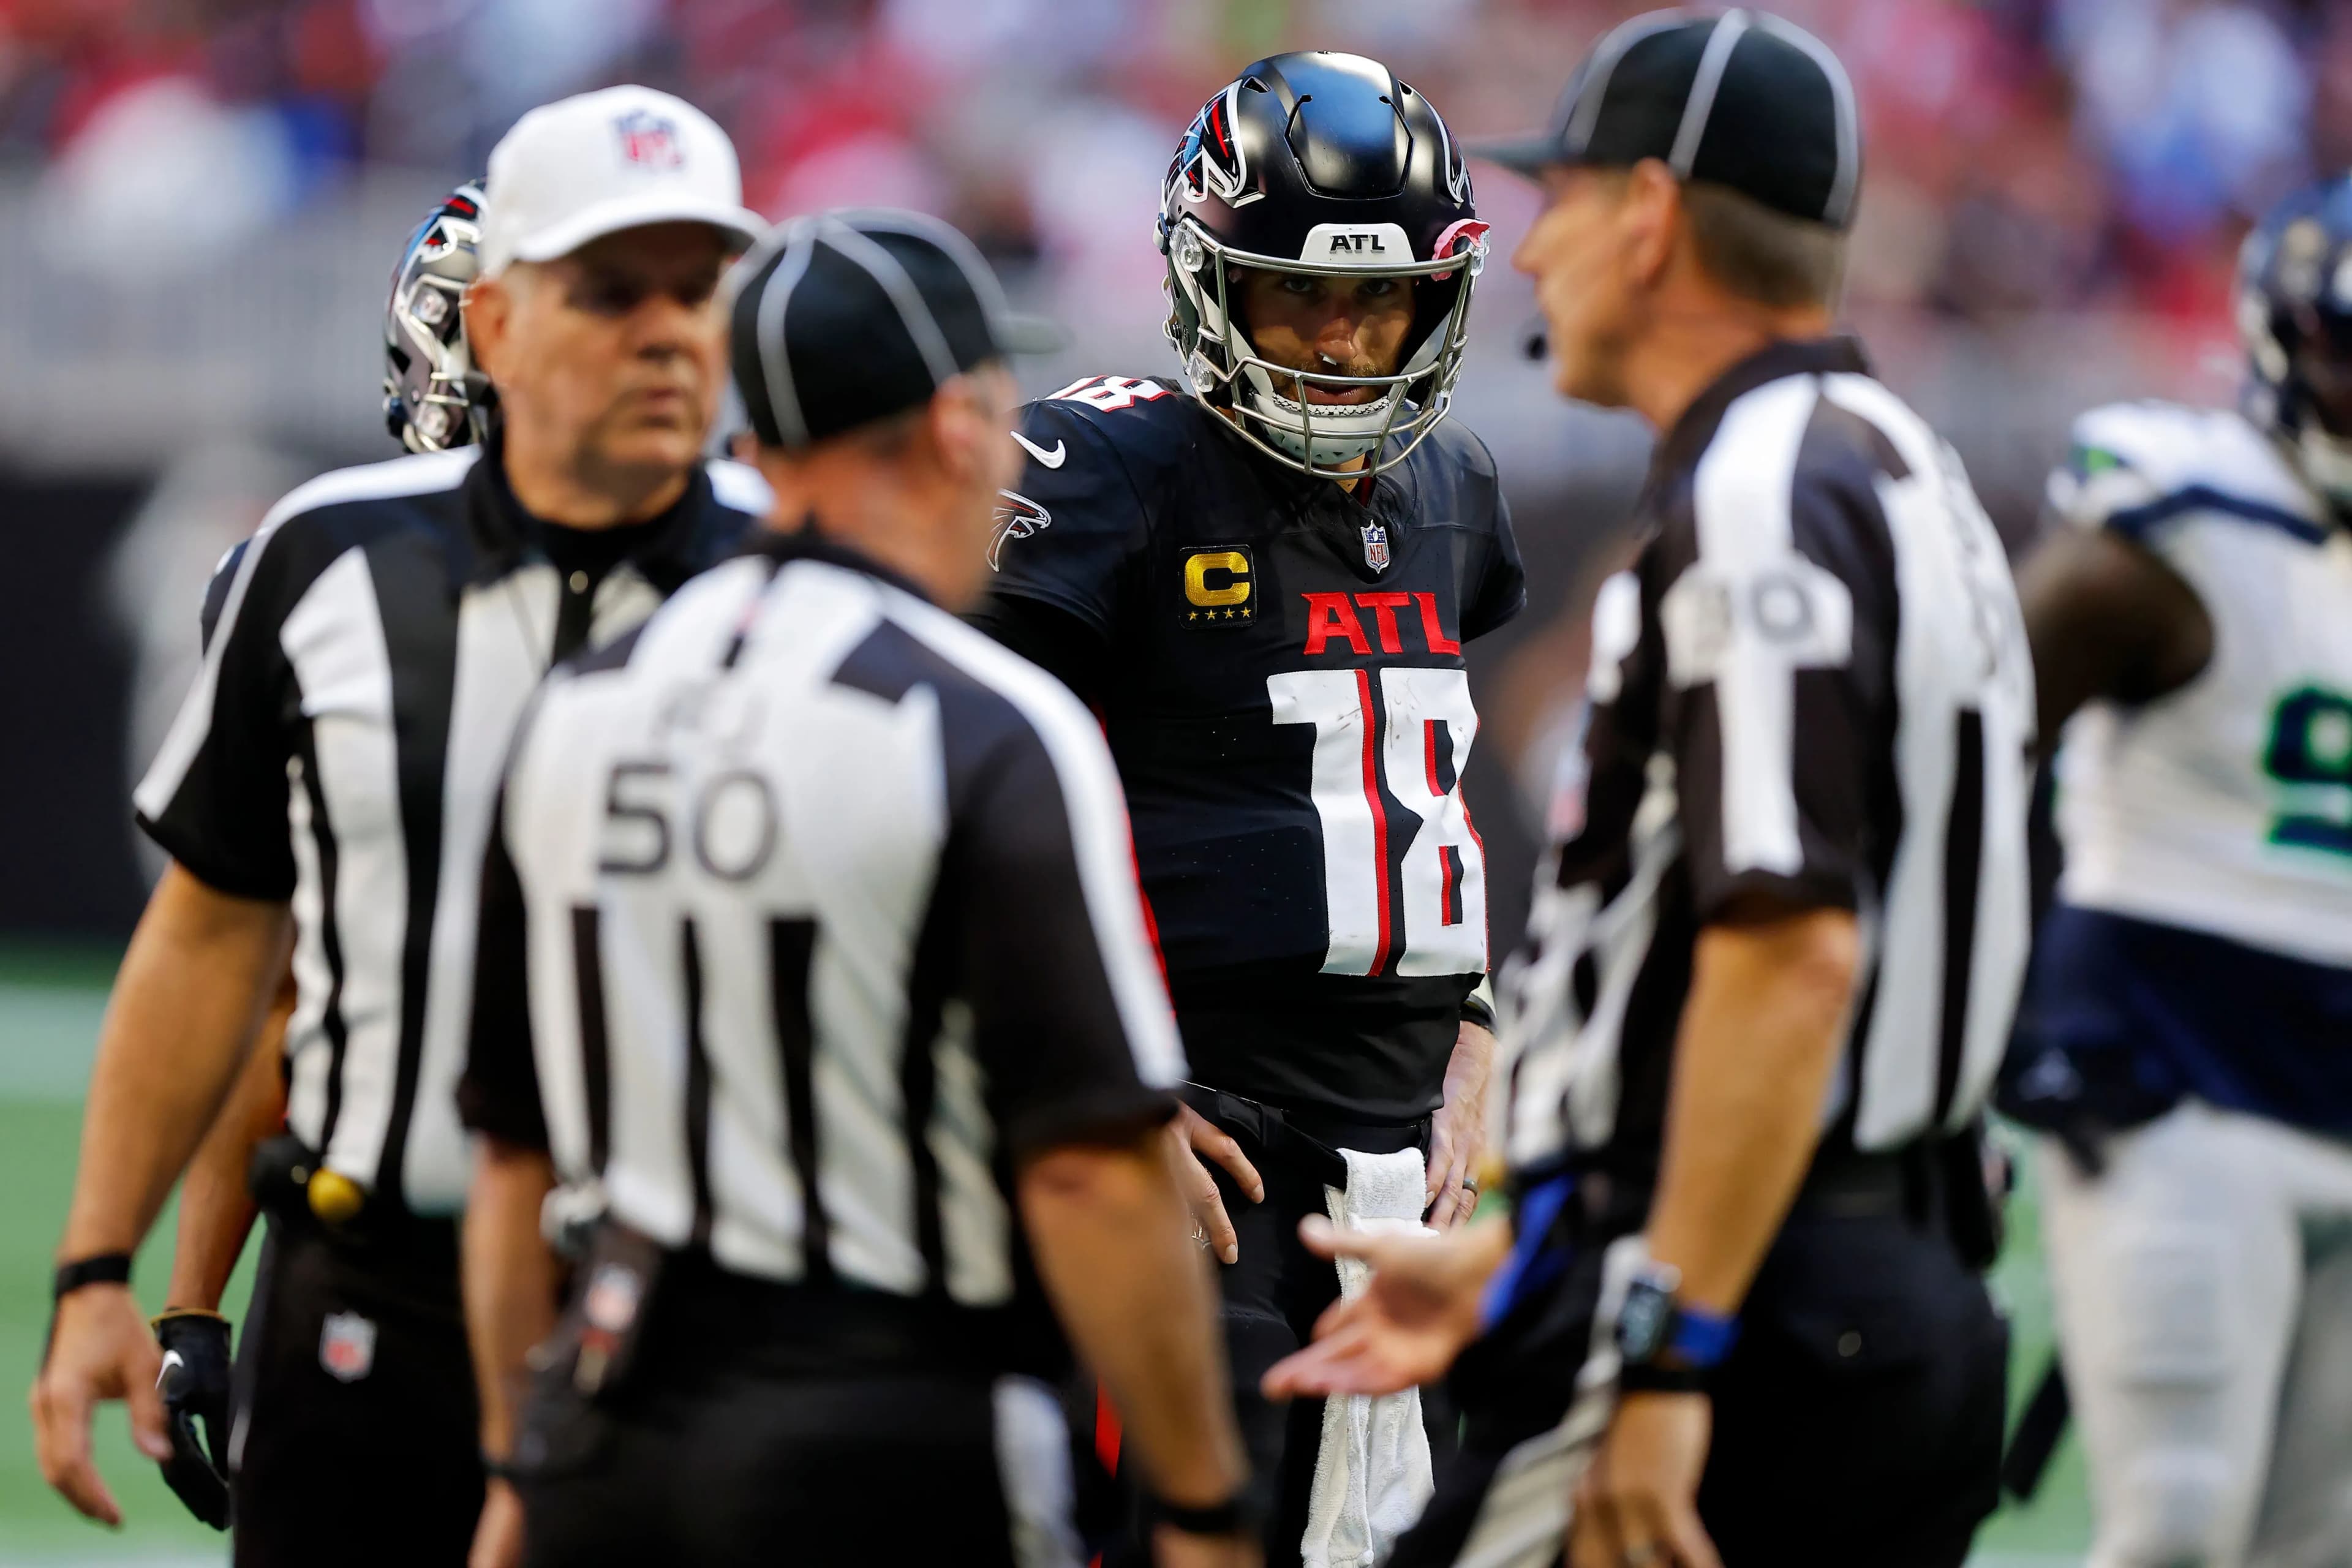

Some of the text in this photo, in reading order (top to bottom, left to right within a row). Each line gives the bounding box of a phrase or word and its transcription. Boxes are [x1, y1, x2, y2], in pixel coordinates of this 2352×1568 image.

[1330, 234, 1385, 252] ATL
[1185, 551, 1251, 606] C
[1369, 544, 1387, 564] NFL
[1300, 592, 1461, 655] ATL
[598, 760, 781, 883] 50
[1267, 667, 1491, 978] 18
